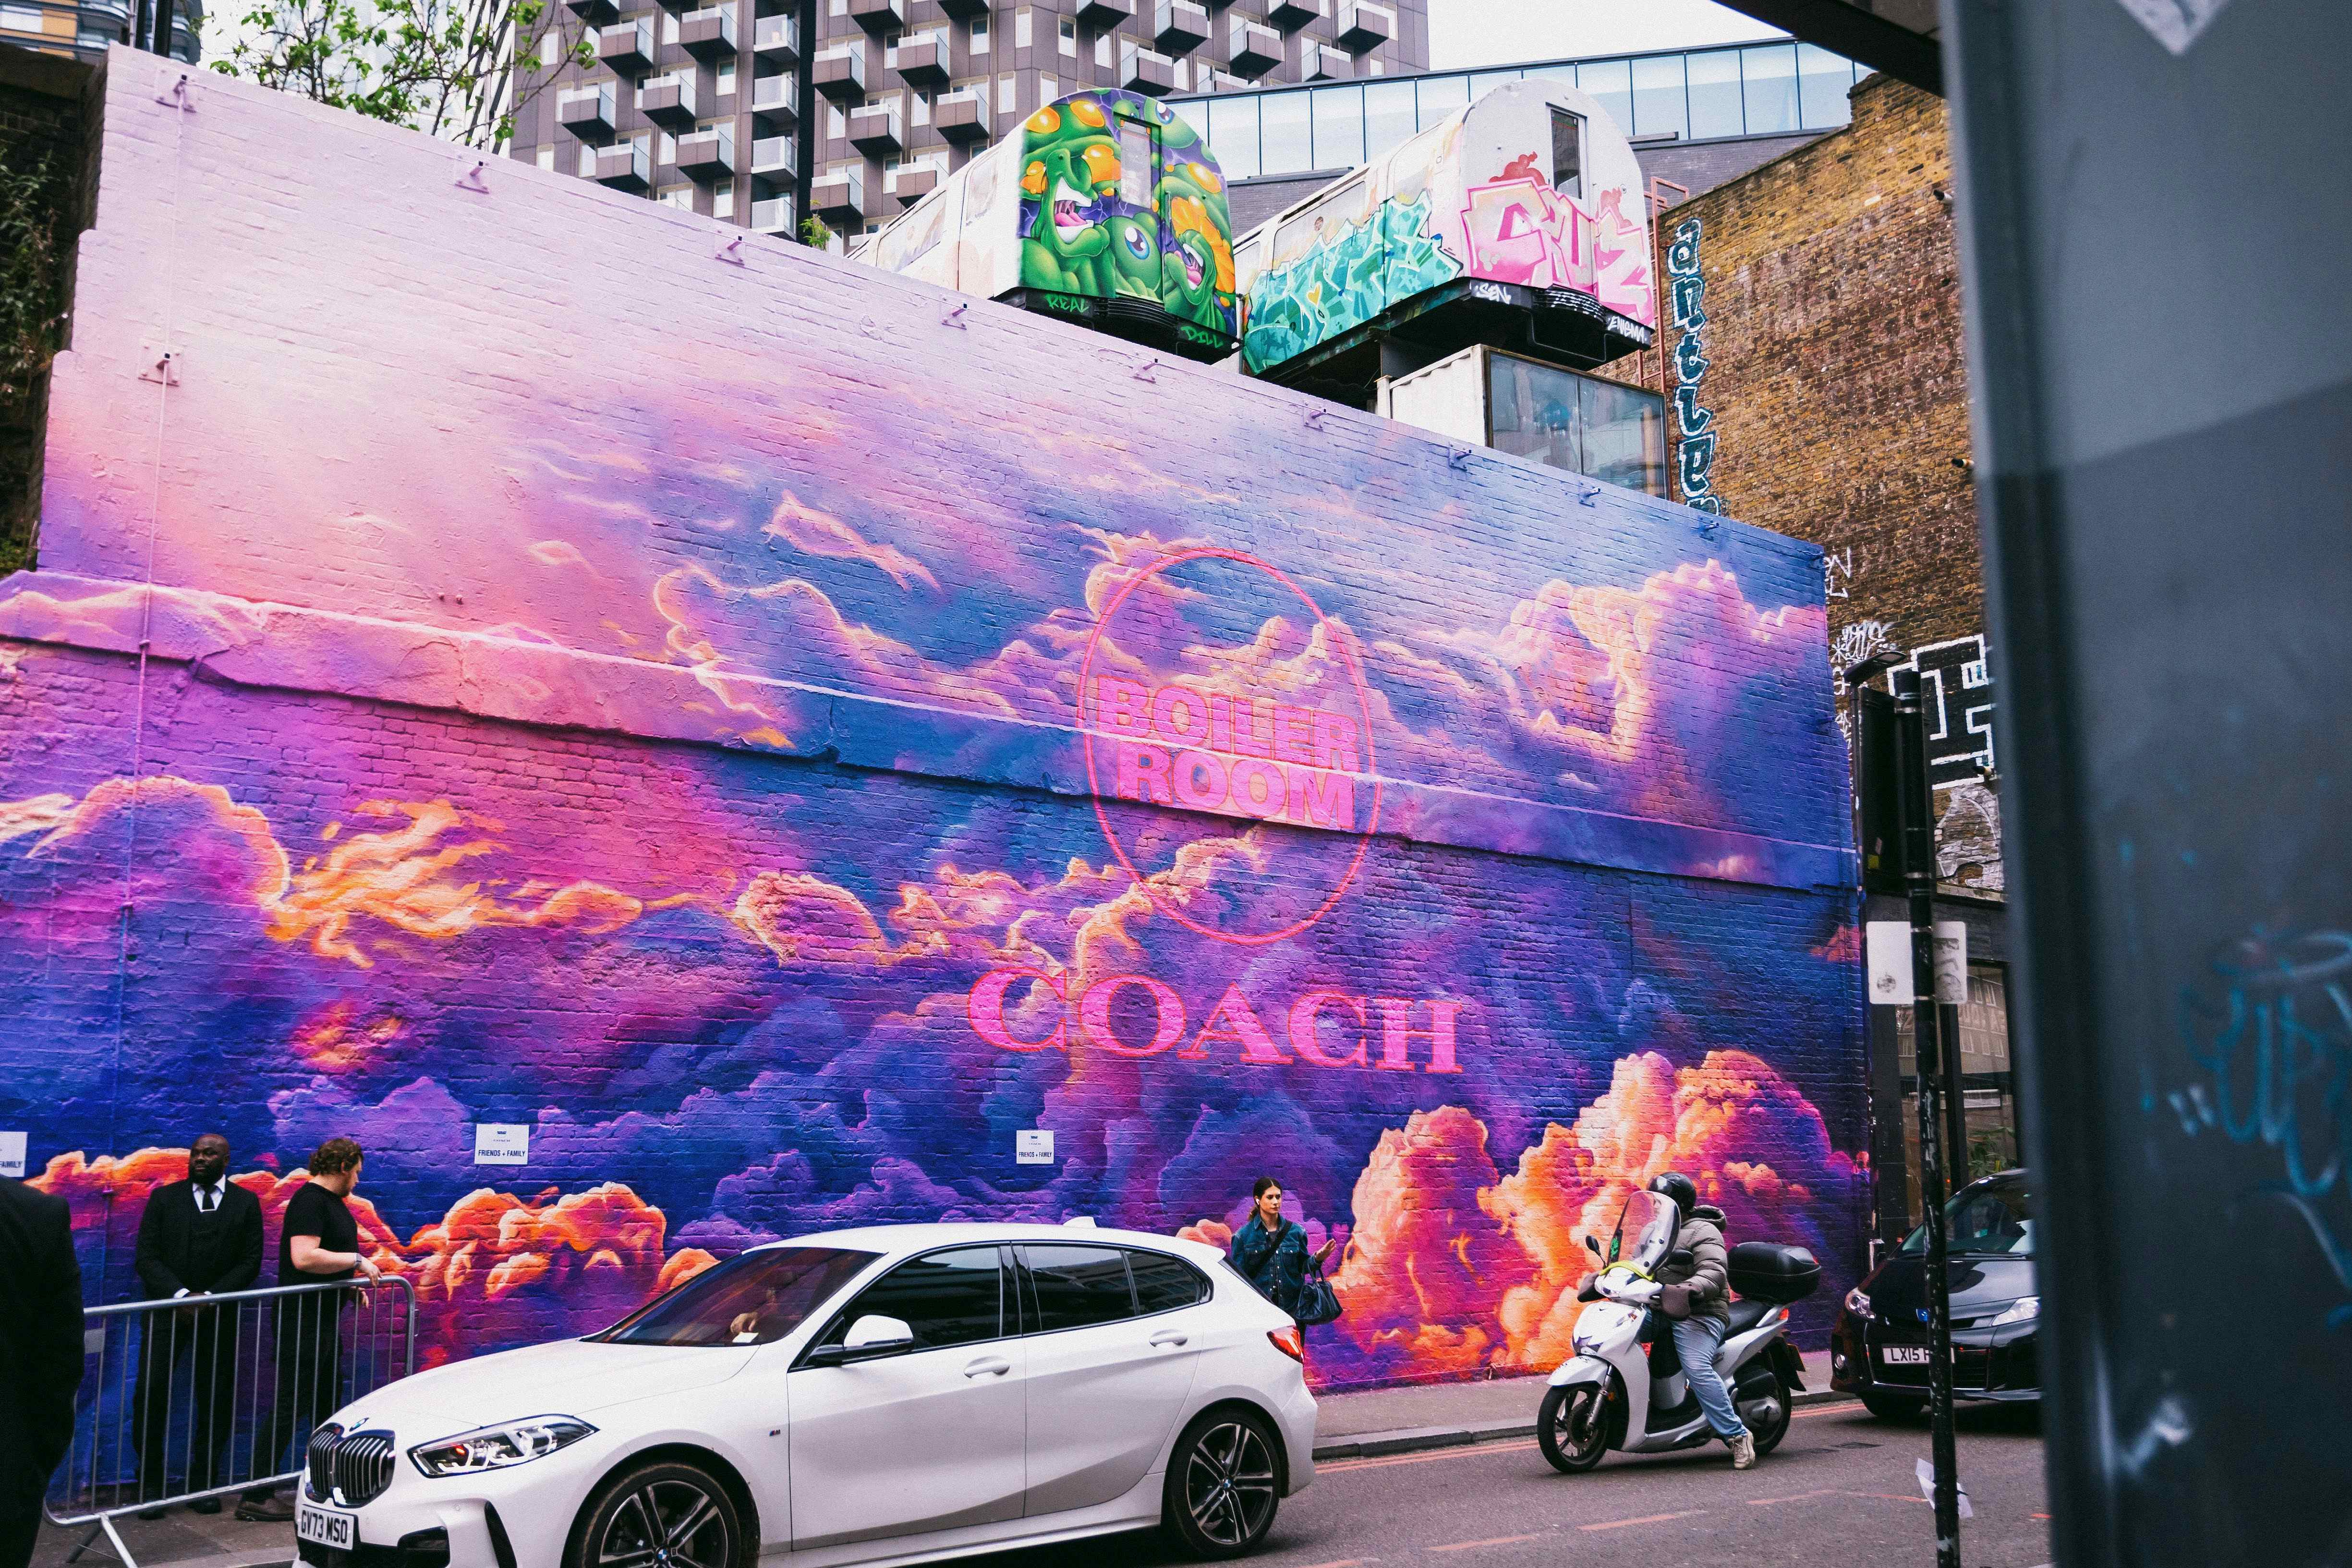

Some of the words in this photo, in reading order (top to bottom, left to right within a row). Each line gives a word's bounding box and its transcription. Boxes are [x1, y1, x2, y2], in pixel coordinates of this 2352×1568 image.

[1044, 293, 1090, 314] REAL
[1095, 674, 1361, 773] BOILER
[1115, 740, 1356, 830] ROOM
[966, 966, 1464, 1074] COACH
[1891, 1348, 1920, 1361] LX15
[301, 1509, 324, 1538] GV73
